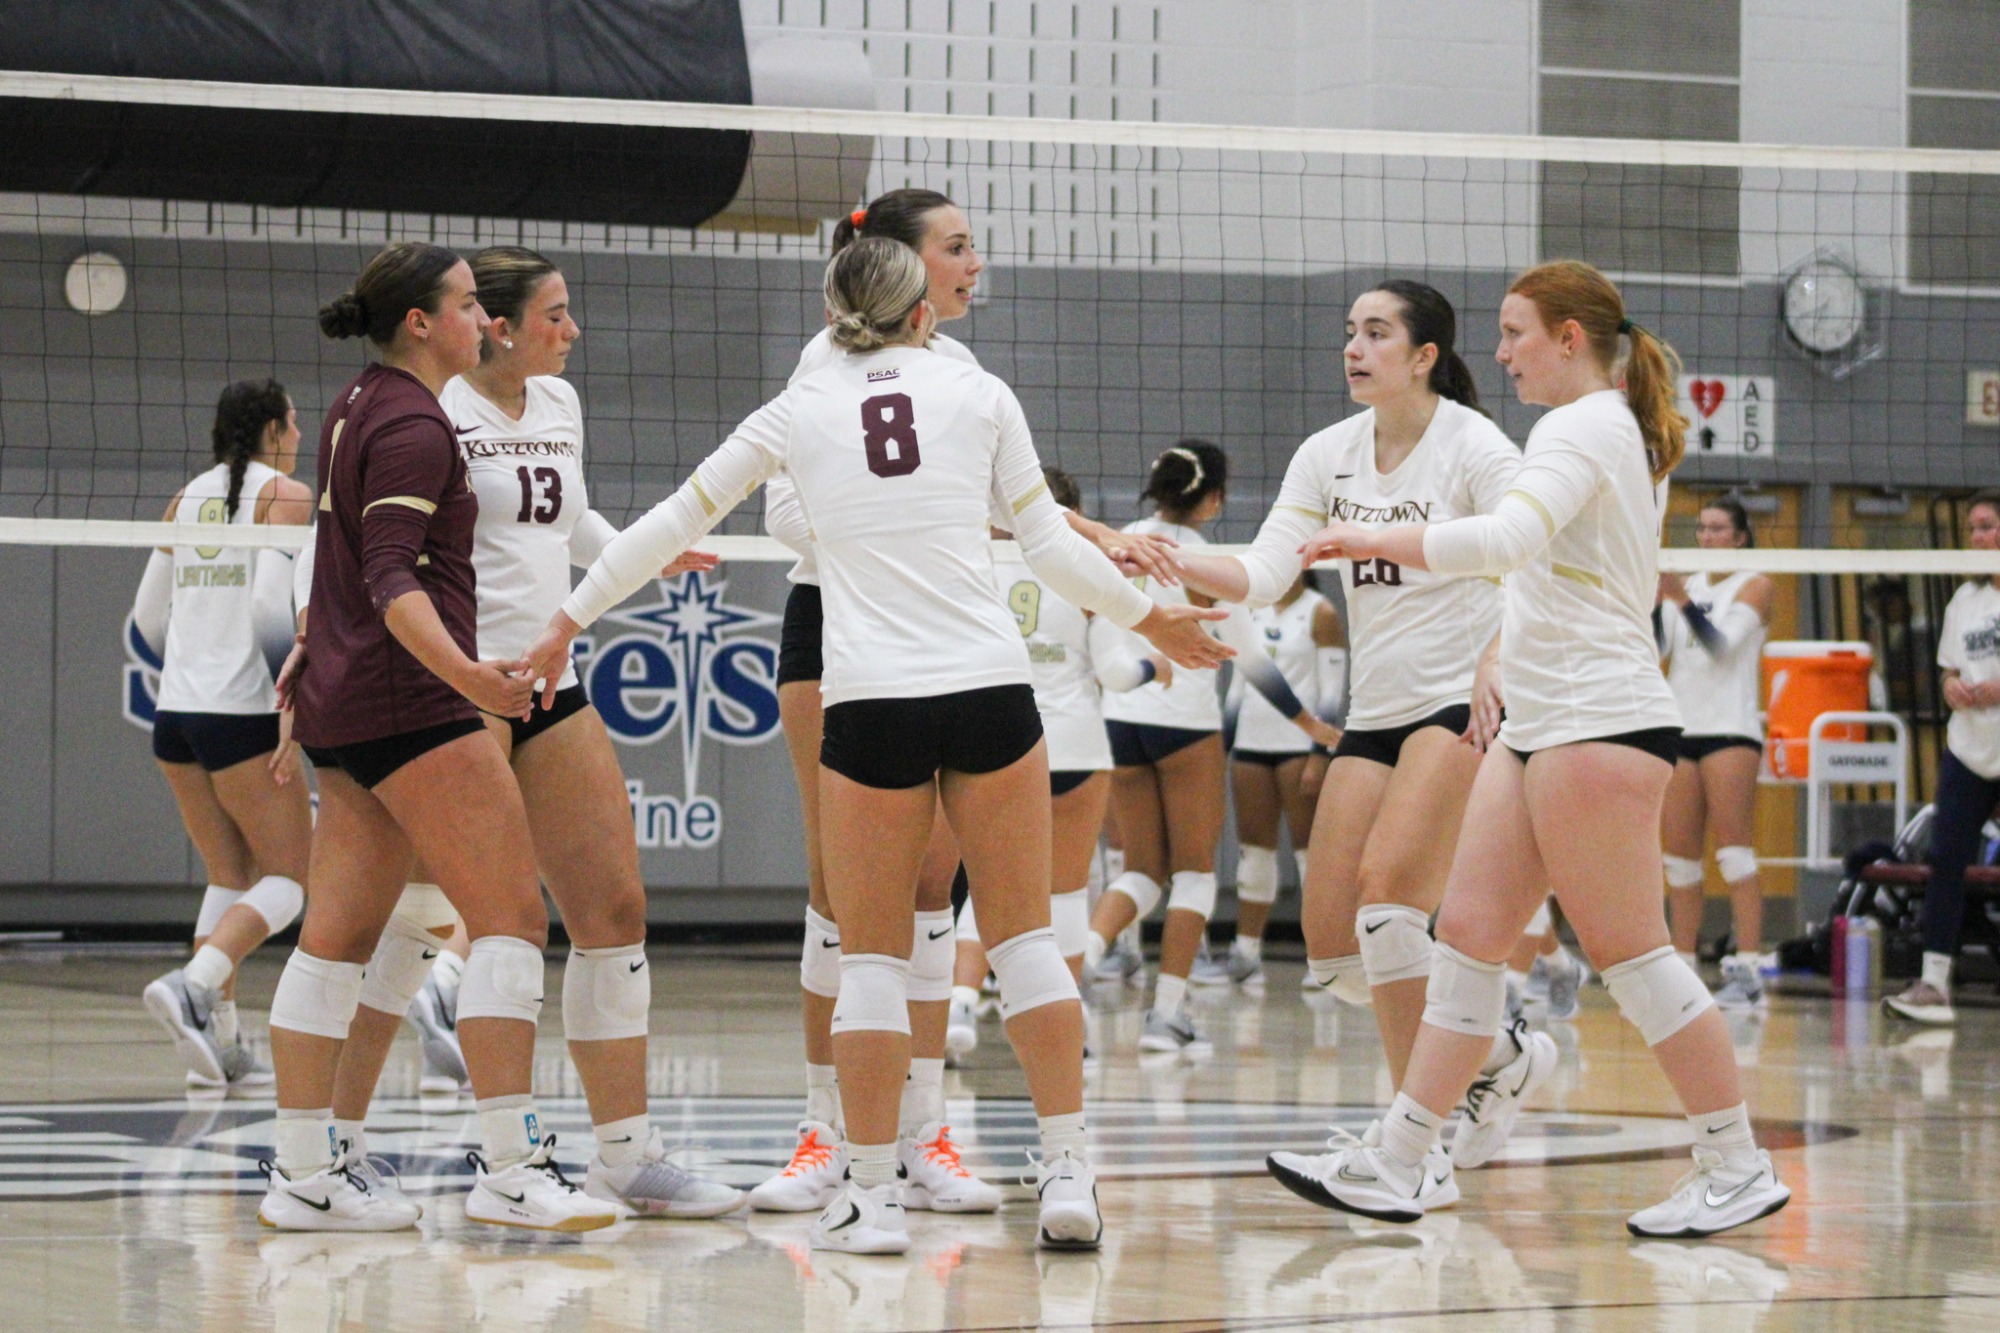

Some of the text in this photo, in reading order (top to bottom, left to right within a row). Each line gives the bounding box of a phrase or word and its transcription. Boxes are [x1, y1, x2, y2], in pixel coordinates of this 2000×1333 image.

[867, 368, 900, 379] PSAC
[463, 440, 575, 460] KUTZTOWN
[861, 392, 921, 478] 8
[516, 465, 562, 524] 13
[1330, 497, 1434, 522] KUTZTOWN
[1008, 580, 1041, 638] 9
